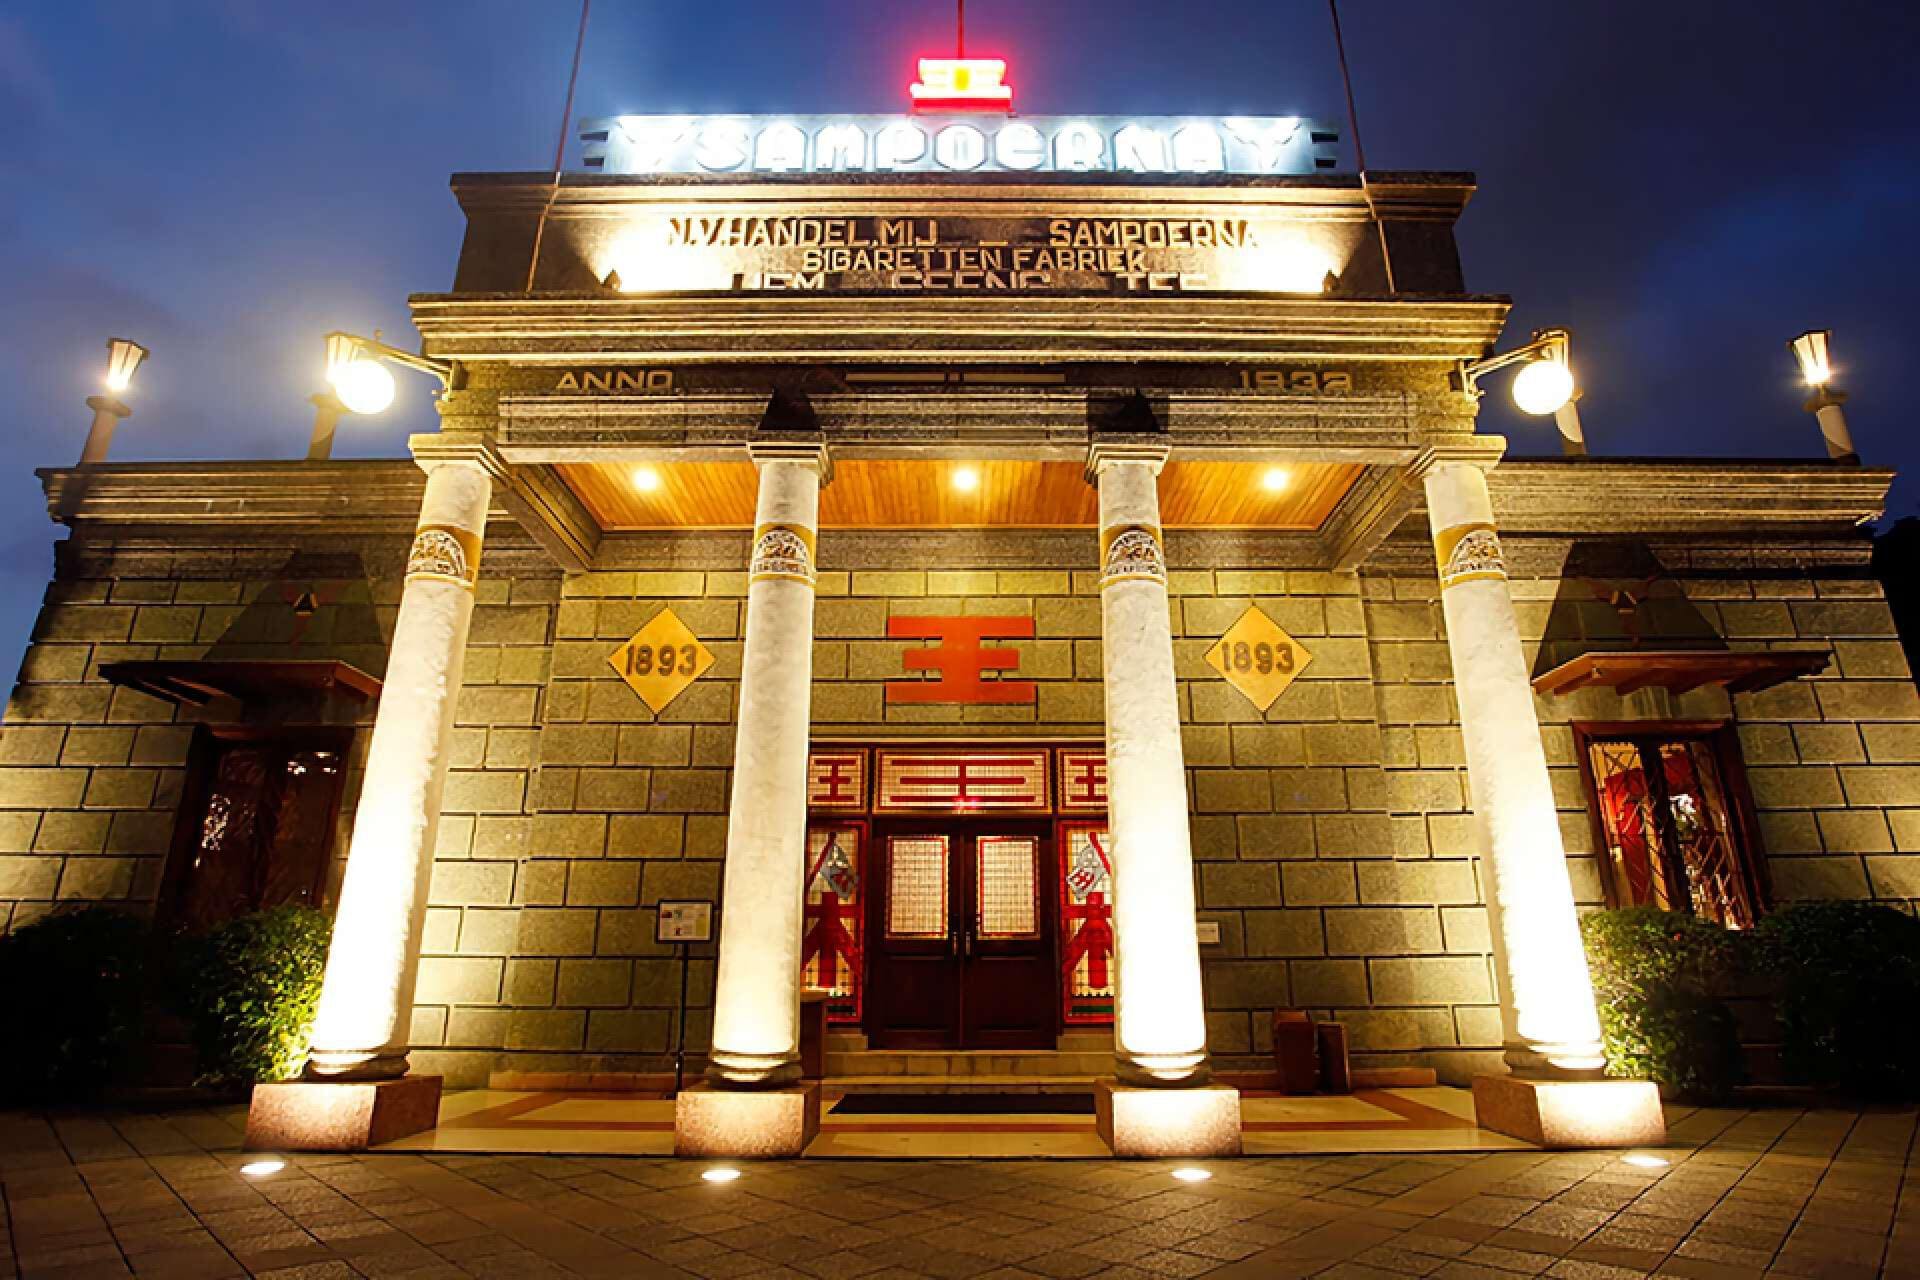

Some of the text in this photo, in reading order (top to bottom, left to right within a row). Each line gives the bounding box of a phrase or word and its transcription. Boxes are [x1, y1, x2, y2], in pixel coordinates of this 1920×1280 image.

[697, 122, 1226, 173] SAMPOERNA
[802, 249, 1149, 272] SIGARETTEN FABRIEK
[556, 370, 673, 391] ANNO
[625, 643, 698, 677] 1893
[1221, 641, 1295, 675] 1893
